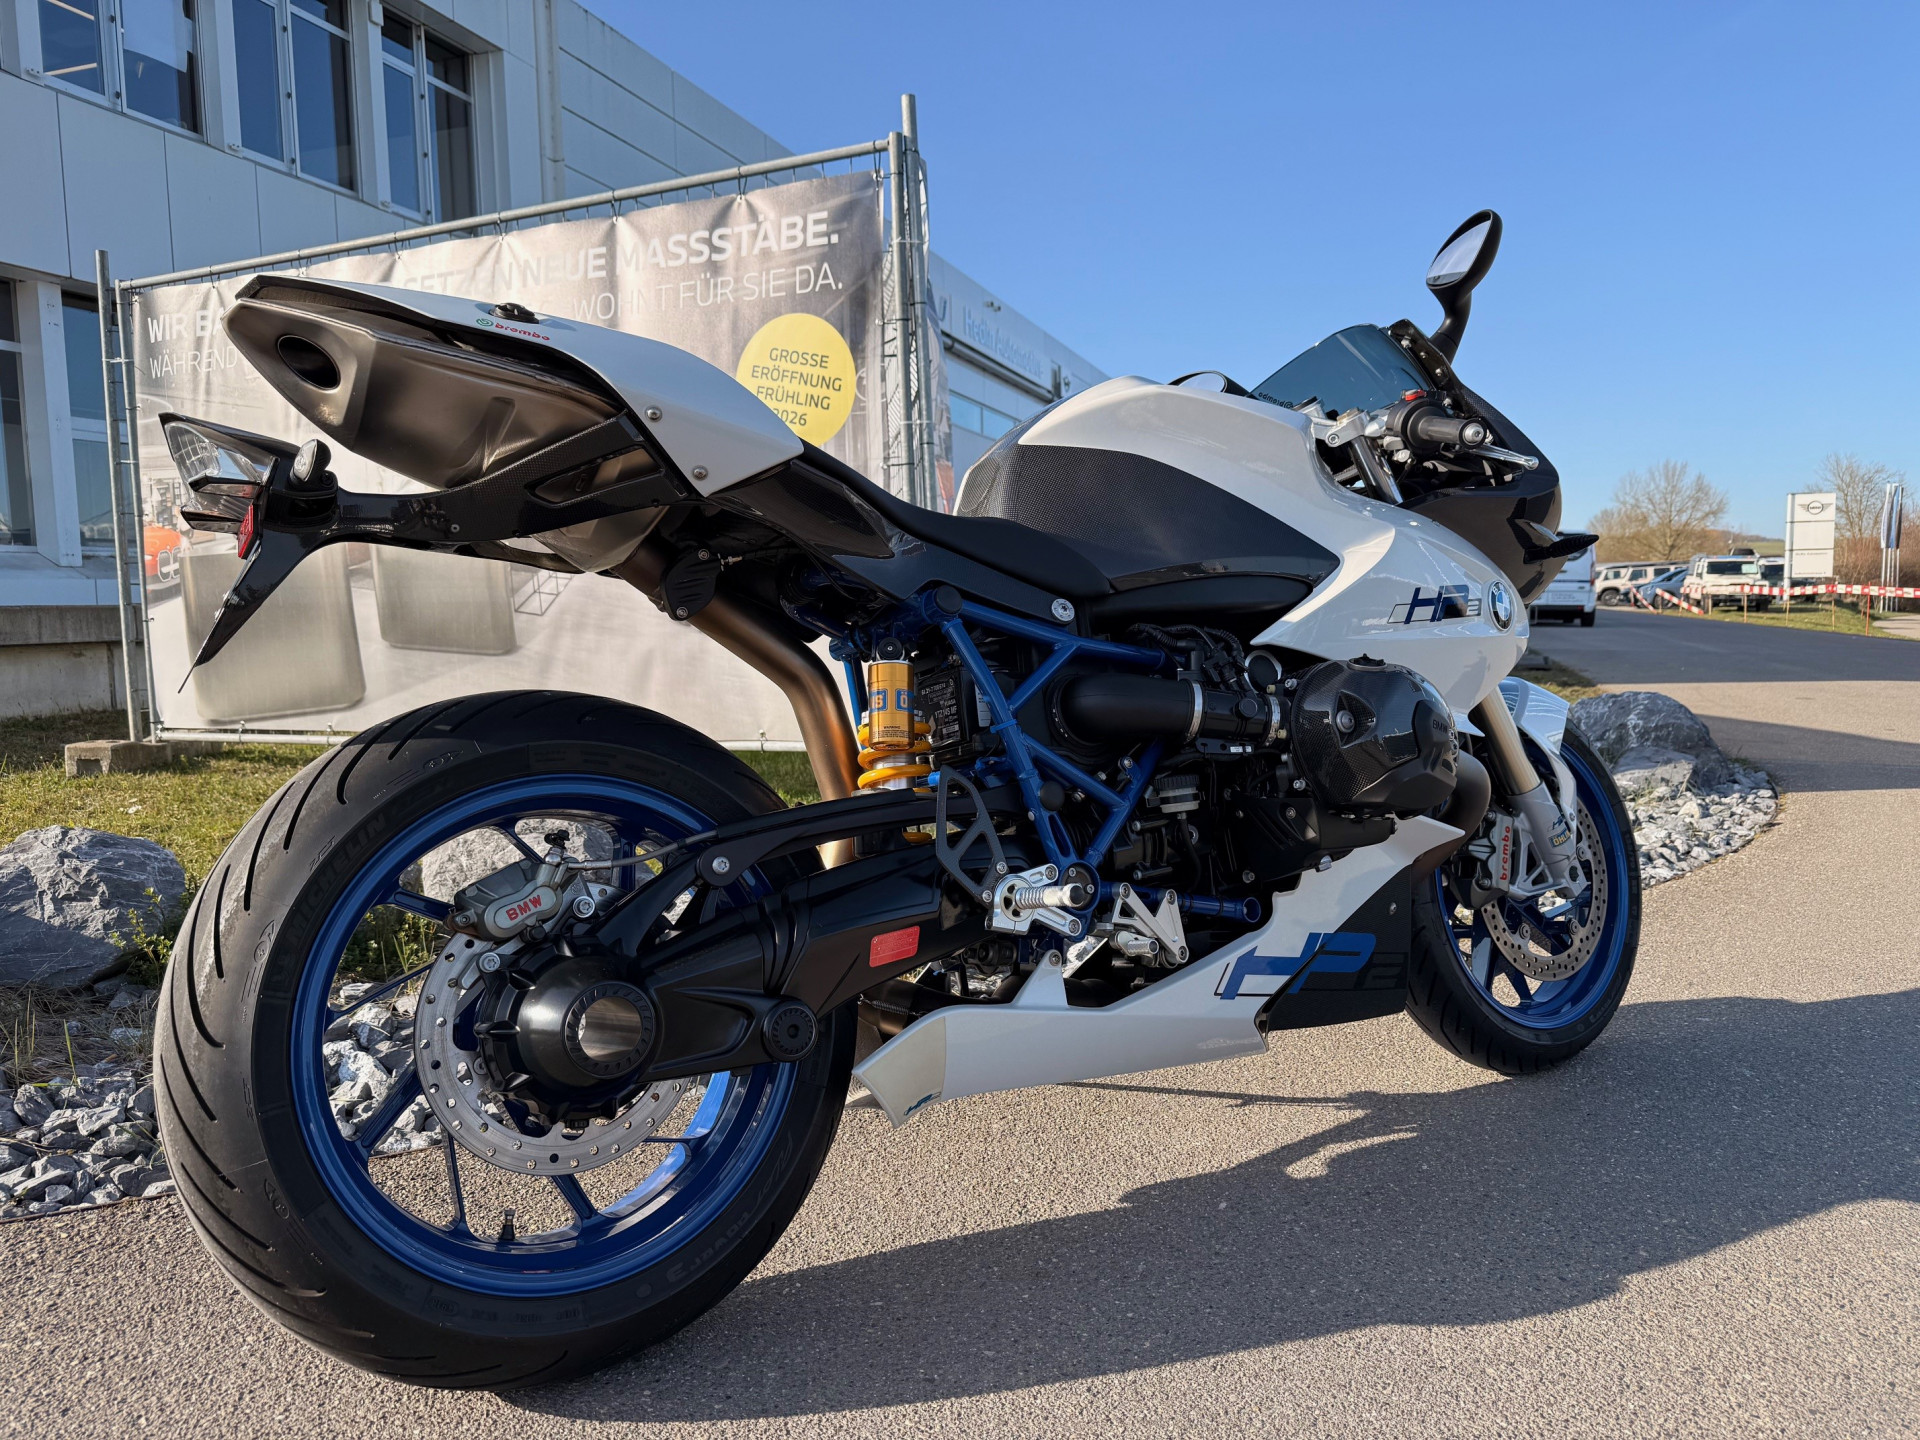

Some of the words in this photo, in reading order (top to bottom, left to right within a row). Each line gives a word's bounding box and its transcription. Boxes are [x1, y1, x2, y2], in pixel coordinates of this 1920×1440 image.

[148, 312, 188, 343] WIR
[521, 246, 607, 289] NEUE
[149, 346, 237, 379] WÄHREND
[679, 272, 734, 309] FÜR
[743, 268, 786, 300] SIE
[795, 261, 843, 295] DA.
[494, 322, 550, 341] brembo
[769, 347, 830, 369] GROSSE
[751, 364, 842, 392] ERÖFFNUNG
[756, 385, 831, 411] FRÜHLING
[1404, 584, 1482, 625] HP2
[1432, 719, 1448, 735] BMW
[1500, 825, 1512, 881] brembo
[505, 894, 542, 922] BMW
